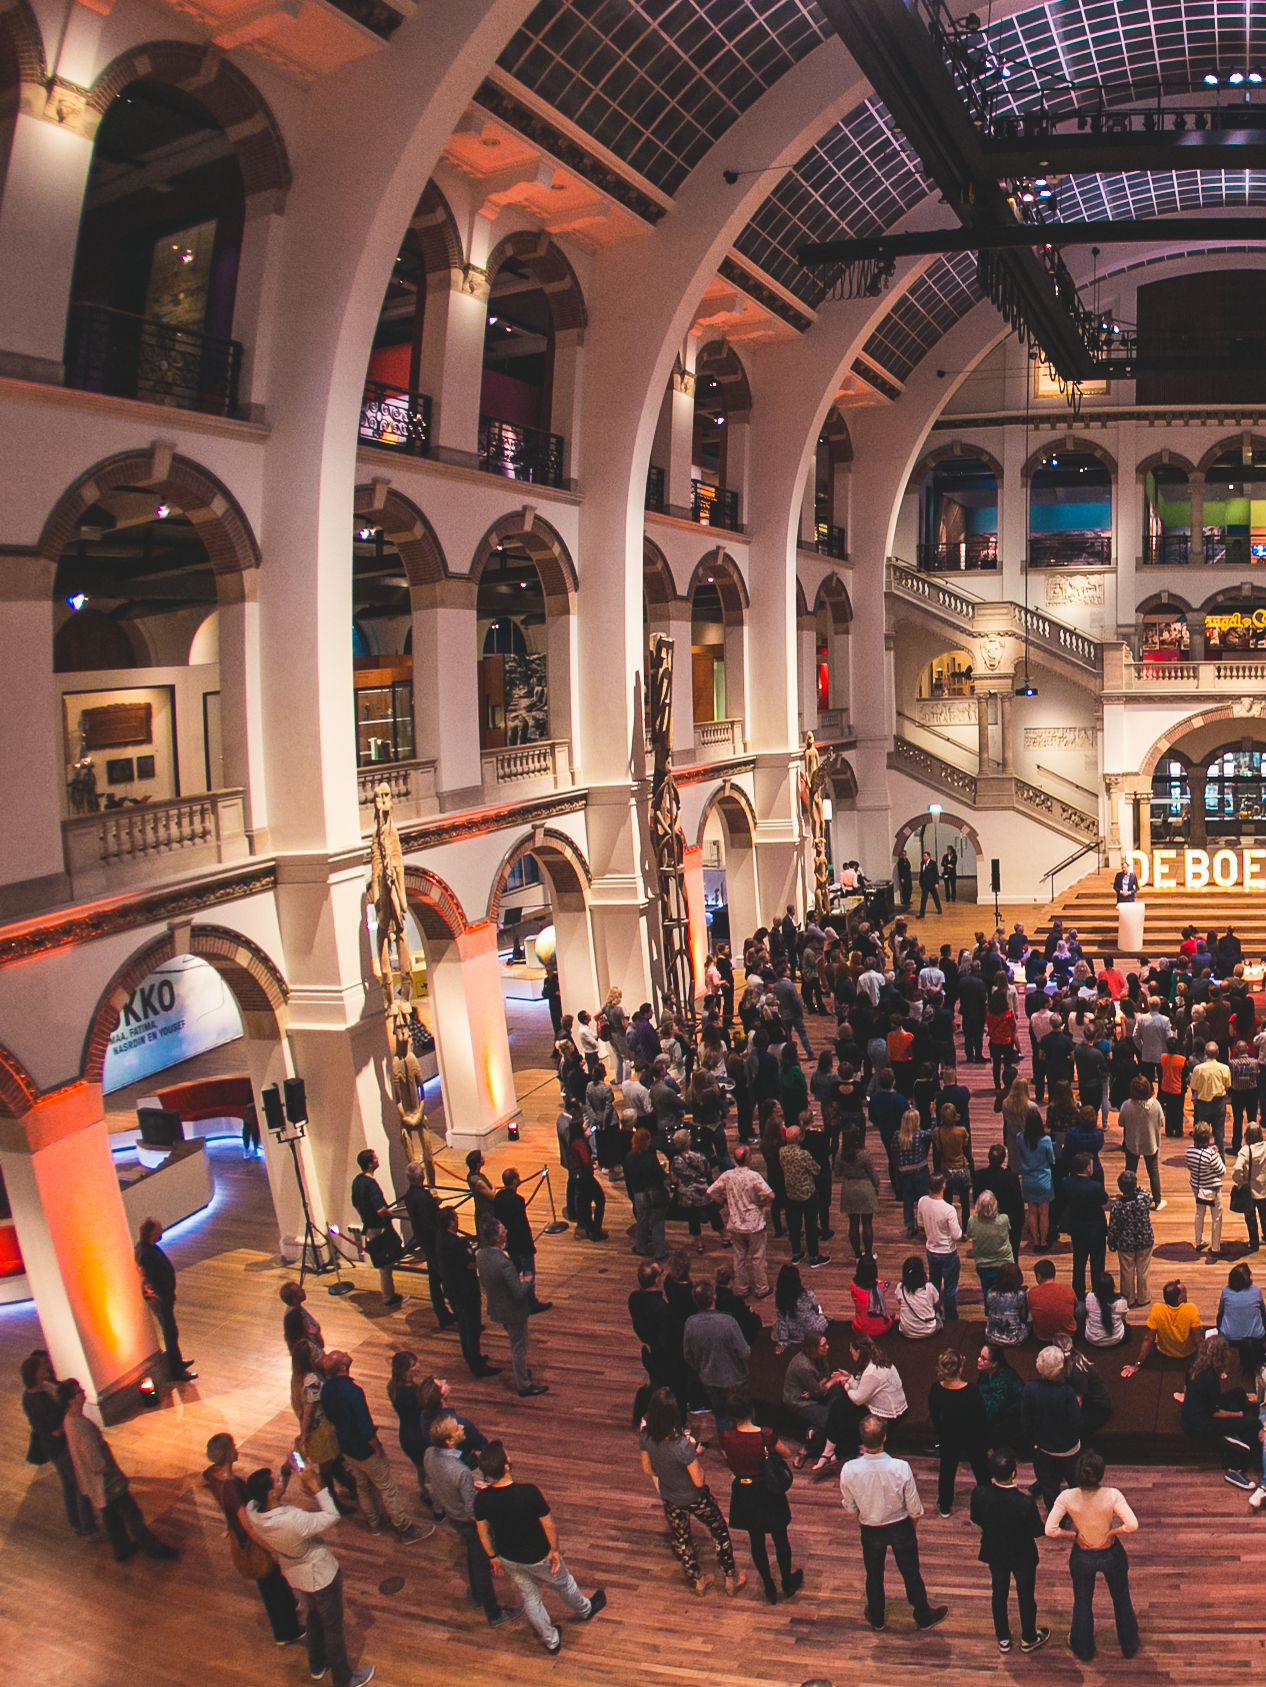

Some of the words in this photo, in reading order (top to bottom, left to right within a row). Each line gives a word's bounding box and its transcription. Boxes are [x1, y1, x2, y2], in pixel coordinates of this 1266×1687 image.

[1126, 849, 1177, 888] DE
[111, 978, 176, 1033] KKO
[129, 1020, 158, 1037] FATIMA,
[148, 1031, 158, 1042] EN
[159, 1019, 186, 1037] YOUSEF
